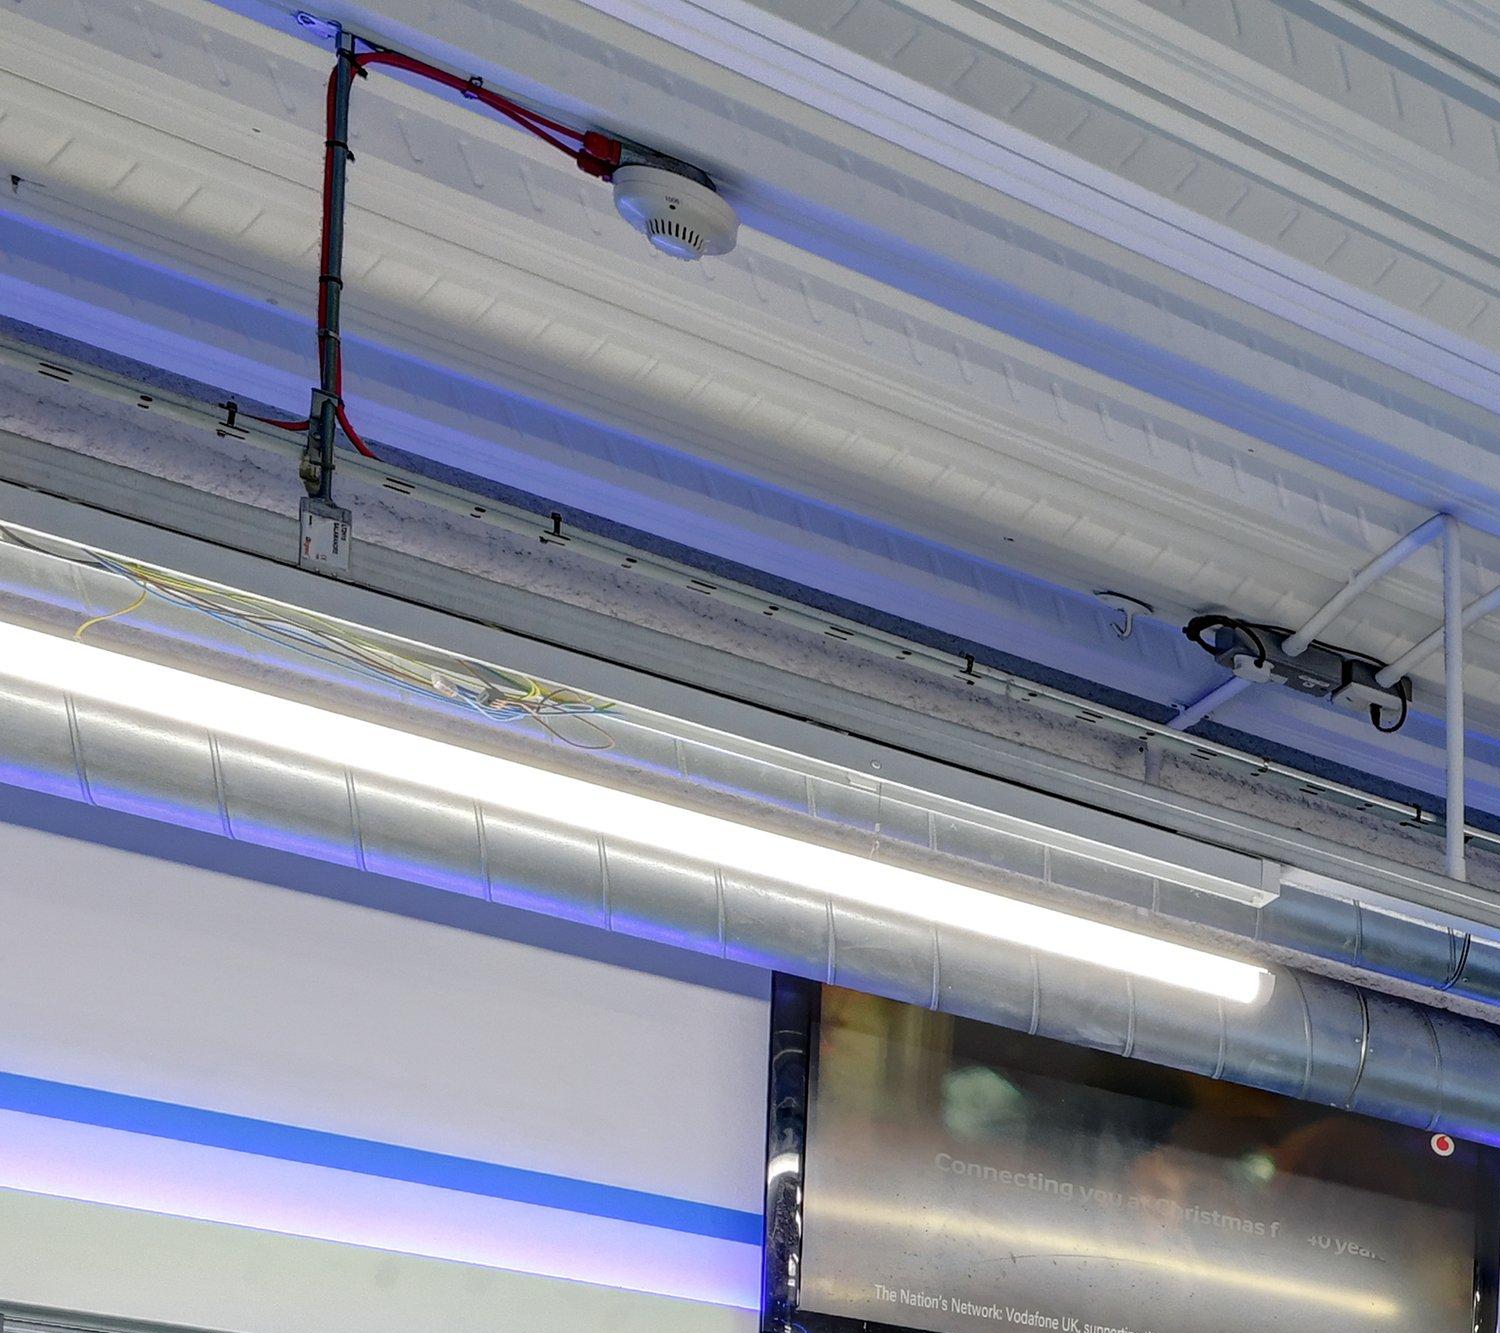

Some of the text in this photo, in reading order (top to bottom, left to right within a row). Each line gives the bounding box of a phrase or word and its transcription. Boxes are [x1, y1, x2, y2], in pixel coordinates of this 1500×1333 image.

[934, 1152, 1074, 1199] Connecting
[875, 1284, 897, 1303] The
[900, 1288, 948, 1311] Nation's
[951, 1297, 1003, 1320] Network:
[1006, 1306, 1059, 1330] Vodafone
[1062, 1316, 1081, 1333] UK,
